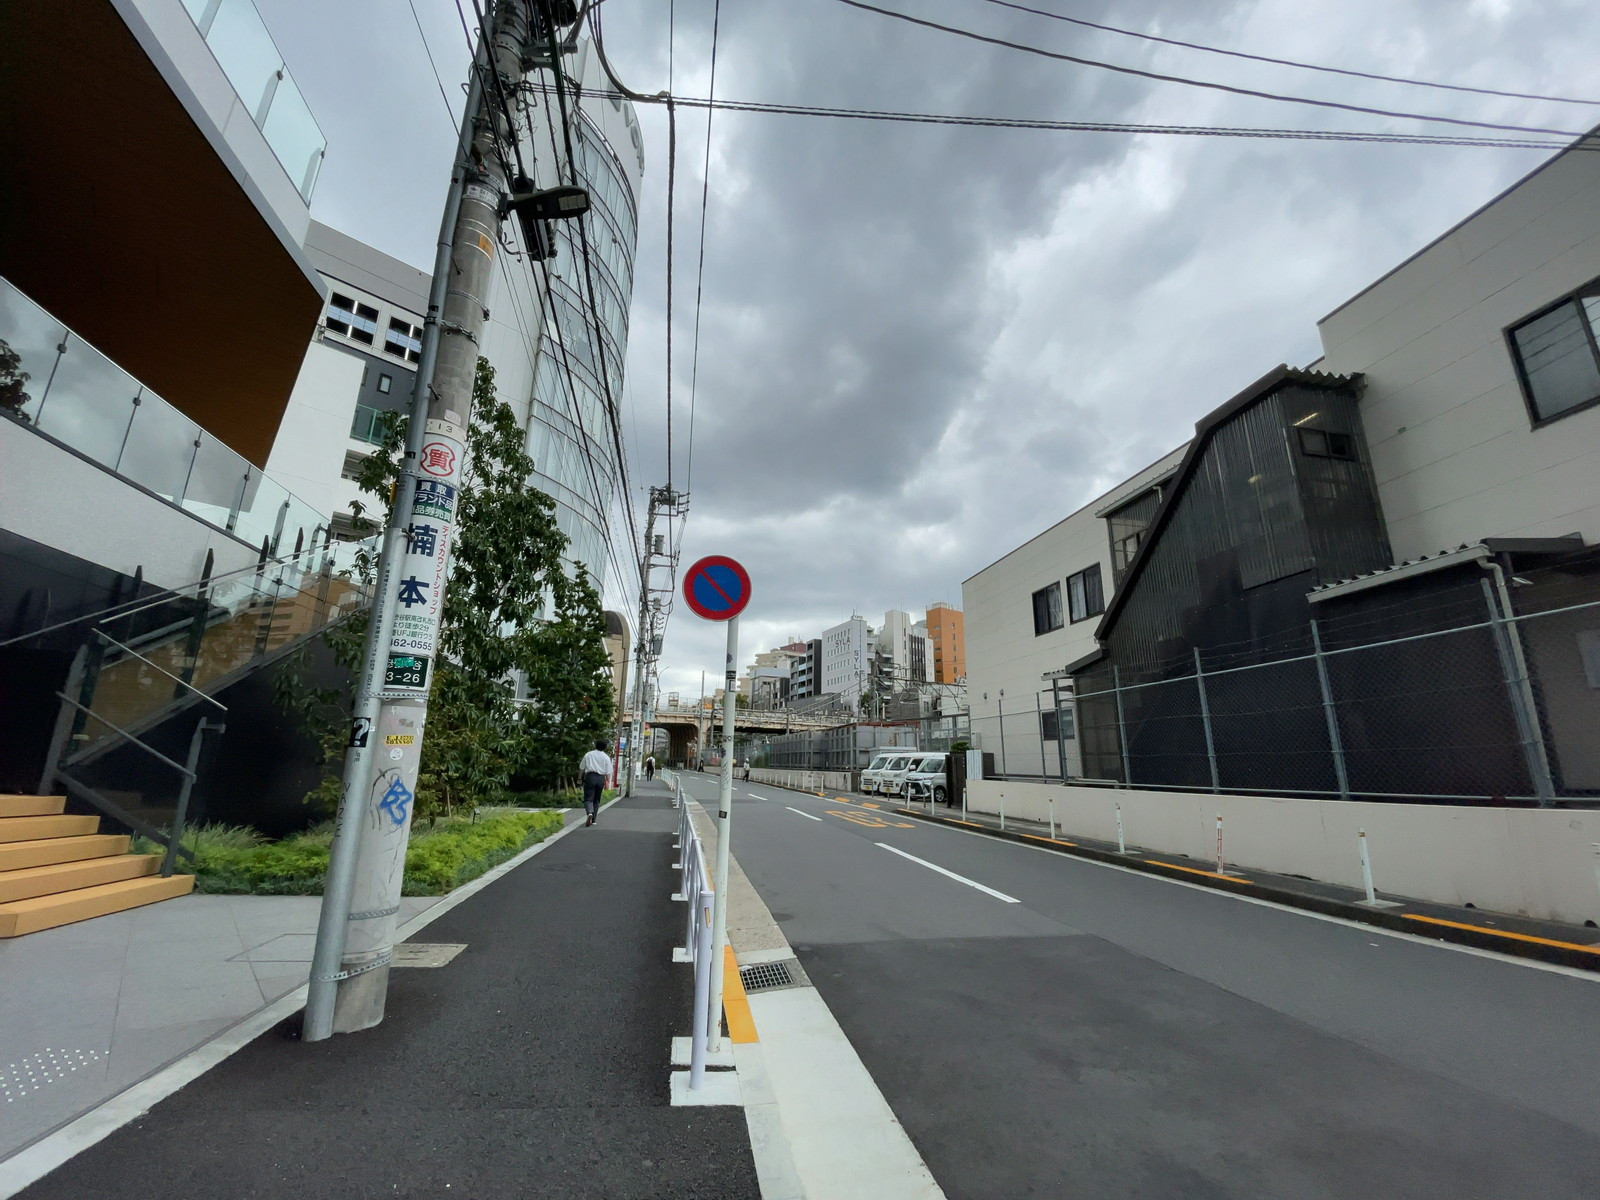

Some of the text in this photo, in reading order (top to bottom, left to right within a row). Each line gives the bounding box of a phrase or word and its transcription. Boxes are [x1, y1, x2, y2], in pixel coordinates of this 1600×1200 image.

[427, 448, 449, 471] 質
[420, 481, 447, 495] 買取
[411, 504, 452, 521] 品券売買
[430, 525, 450, 615] ディスカウントショップ
[835, 635, 851, 649] SYLA
[385, 671, 421, 683] 3-26
